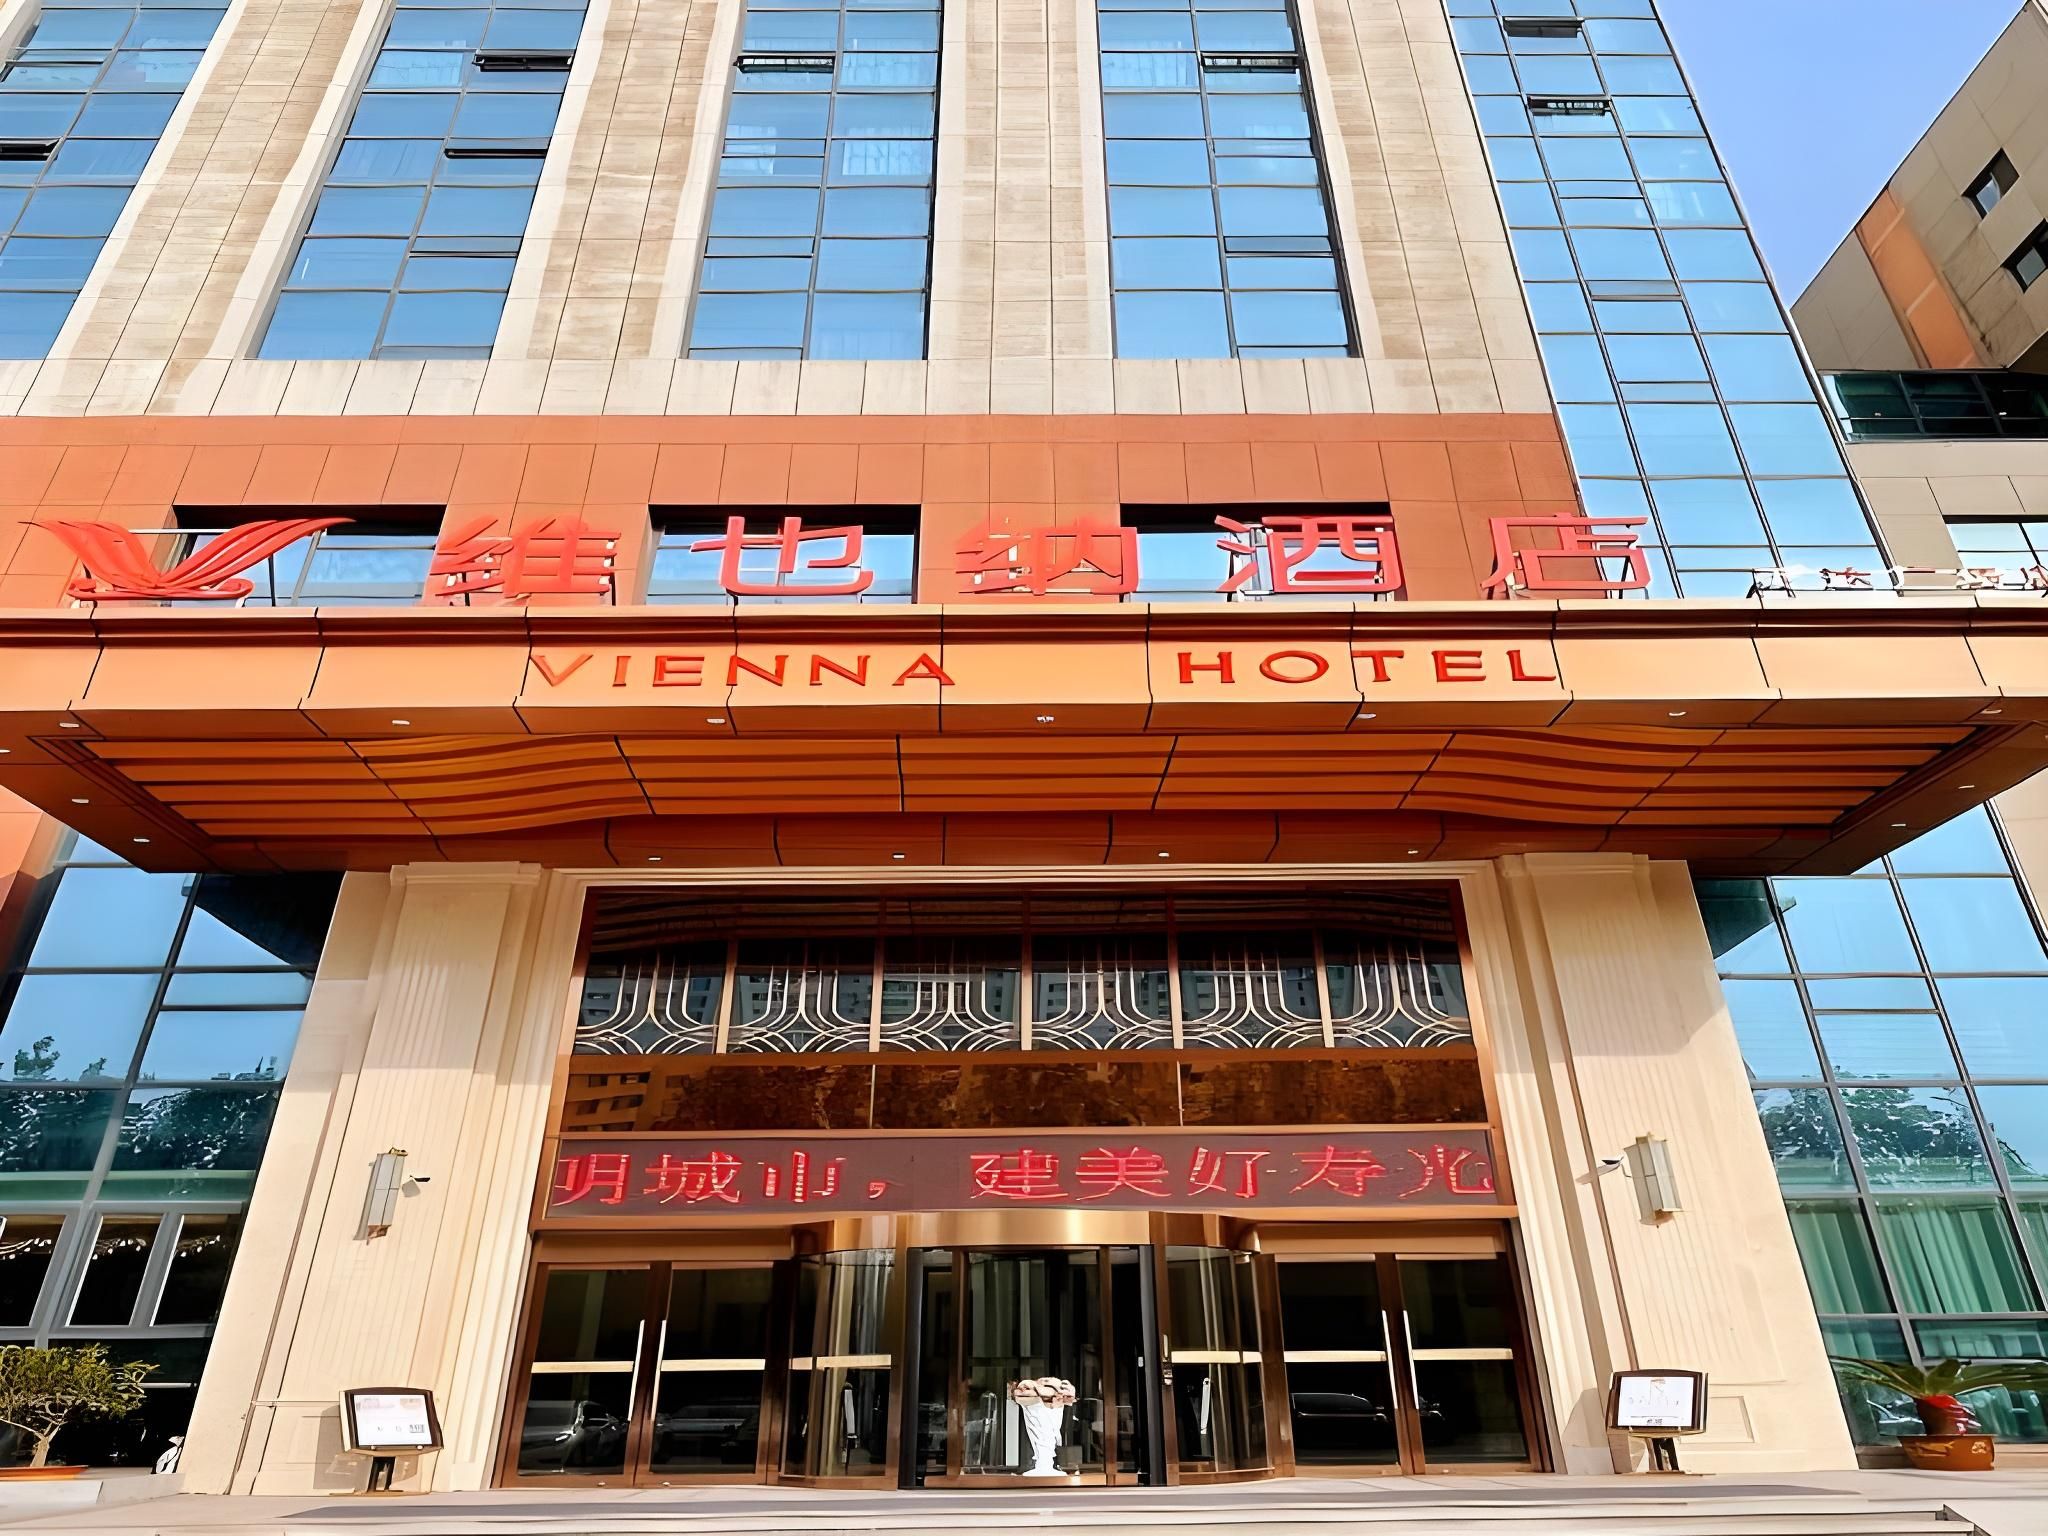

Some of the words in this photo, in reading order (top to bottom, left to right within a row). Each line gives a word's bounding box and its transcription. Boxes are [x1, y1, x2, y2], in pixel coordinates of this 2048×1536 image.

[430, 514, 1651, 599] 维也纳酒店
[530, 650, 955, 688] VIENNA
[1177, 649, 1557, 684] HOTEL
